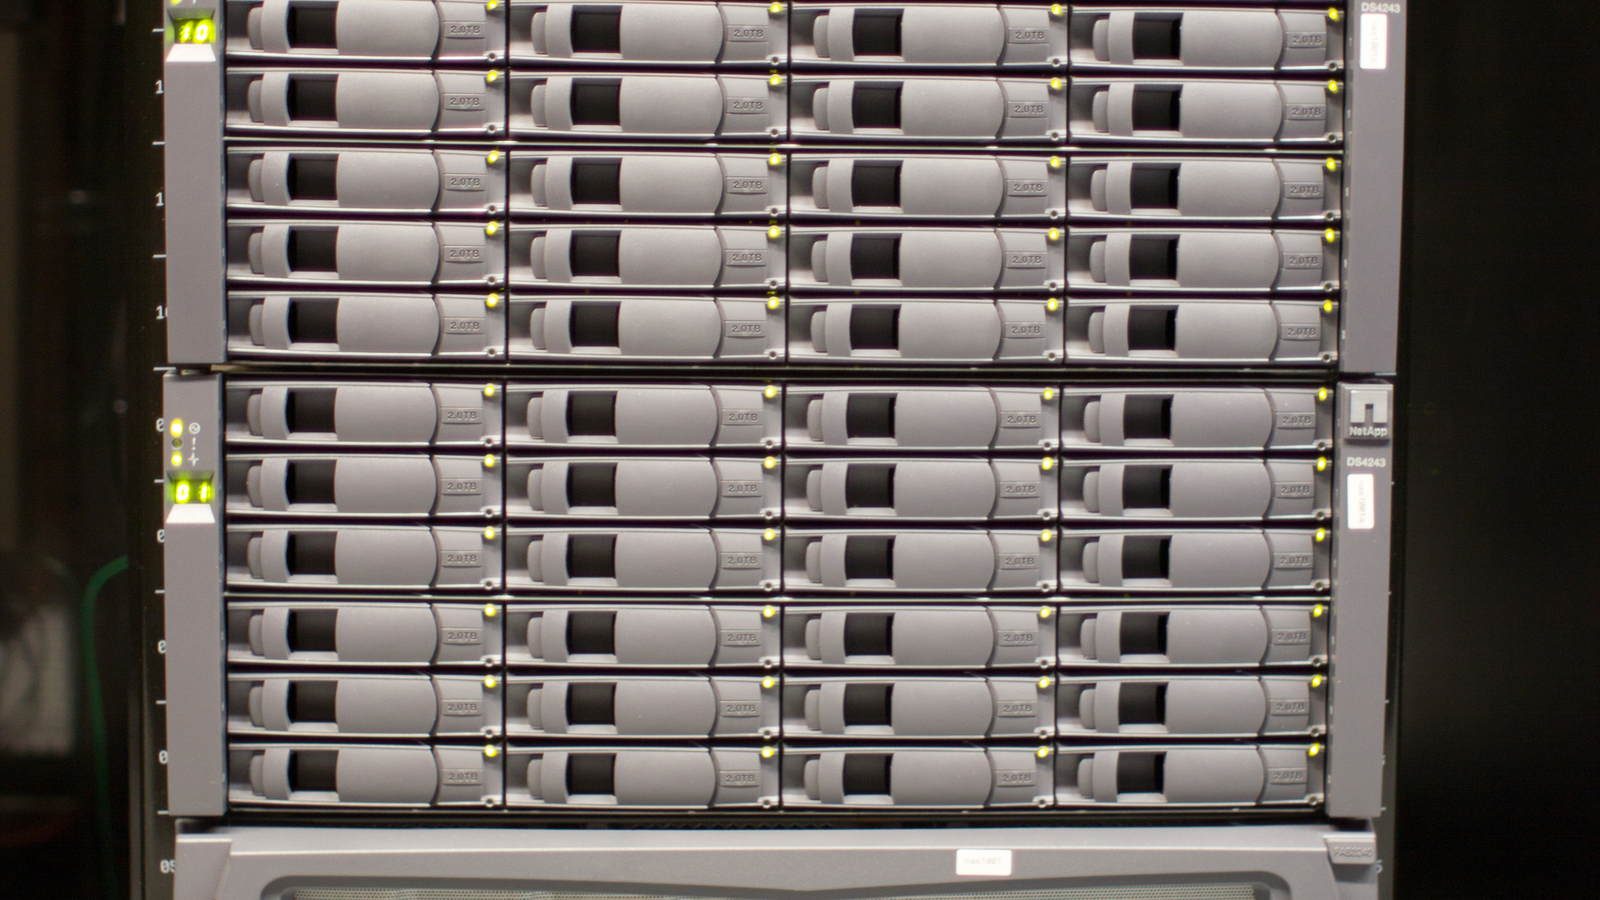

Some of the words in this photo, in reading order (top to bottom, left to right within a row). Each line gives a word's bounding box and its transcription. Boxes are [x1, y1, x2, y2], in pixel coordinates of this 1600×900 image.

[1361, 2, 1401, 13] DS4243
[179, 20, 210, 44] 10
[450, 25, 480, 35] 2.0TB
[733, 28, 763, 38] 2.0TB
[1015, 30, 1045, 40] 2.0TB
[449, 97, 479, 107] 2.0TB
[733, 100, 763, 110] 2.0TB
[1014, 104, 1044, 114] 2.0TB
[450, 177, 480, 187] 2.0TB
[732, 180, 762, 190] 2.0TB
[1013, 183, 1043, 193] 2.0TB
[449, 249, 479, 259] 2.0TB
[731, 253, 761, 263] 2.0TB
[1011, 255, 1041, 265] 2.0TB
[450, 321, 480, 331] 2.0TB
[731, 324, 761, 334] 2.0TB
[1011, 325, 1041, 335] 2.0TB
[447, 410, 477, 420] 2.0TB
[728, 412, 758, 422] 2.0TB
[1006, 415, 1036, 425] 2.0TB
[1349, 426, 1388, 437] NetApp
[1346, 456, 1387, 468] DS4243
[447, 481, 477, 491] 2.0TB
[727, 484, 757, 494] 2.0TB
[1005, 485, 1035, 495] 2.0TB
[176, 481, 208, 503] 01
[447, 554, 477, 564] 2.0TB
[727, 555, 757, 565] 2.0TB
[1004, 556, 1034, 566] 2.0TB
[447, 631, 477, 641] 2.0TB
[726, 633, 756, 643] 2.0TB
[1003, 633, 1033, 643] 2.0TB
[447, 702, 477, 712] 2.0TB
[726, 703, 756, 713] 2.0TB
[1003, 703, 1033, 713] 2.0TB
[448, 772, 478, 782] 2.0TB
[725, 773, 755, 783] 2.0TB
[1001, 773, 1031, 783] 2.0TB
